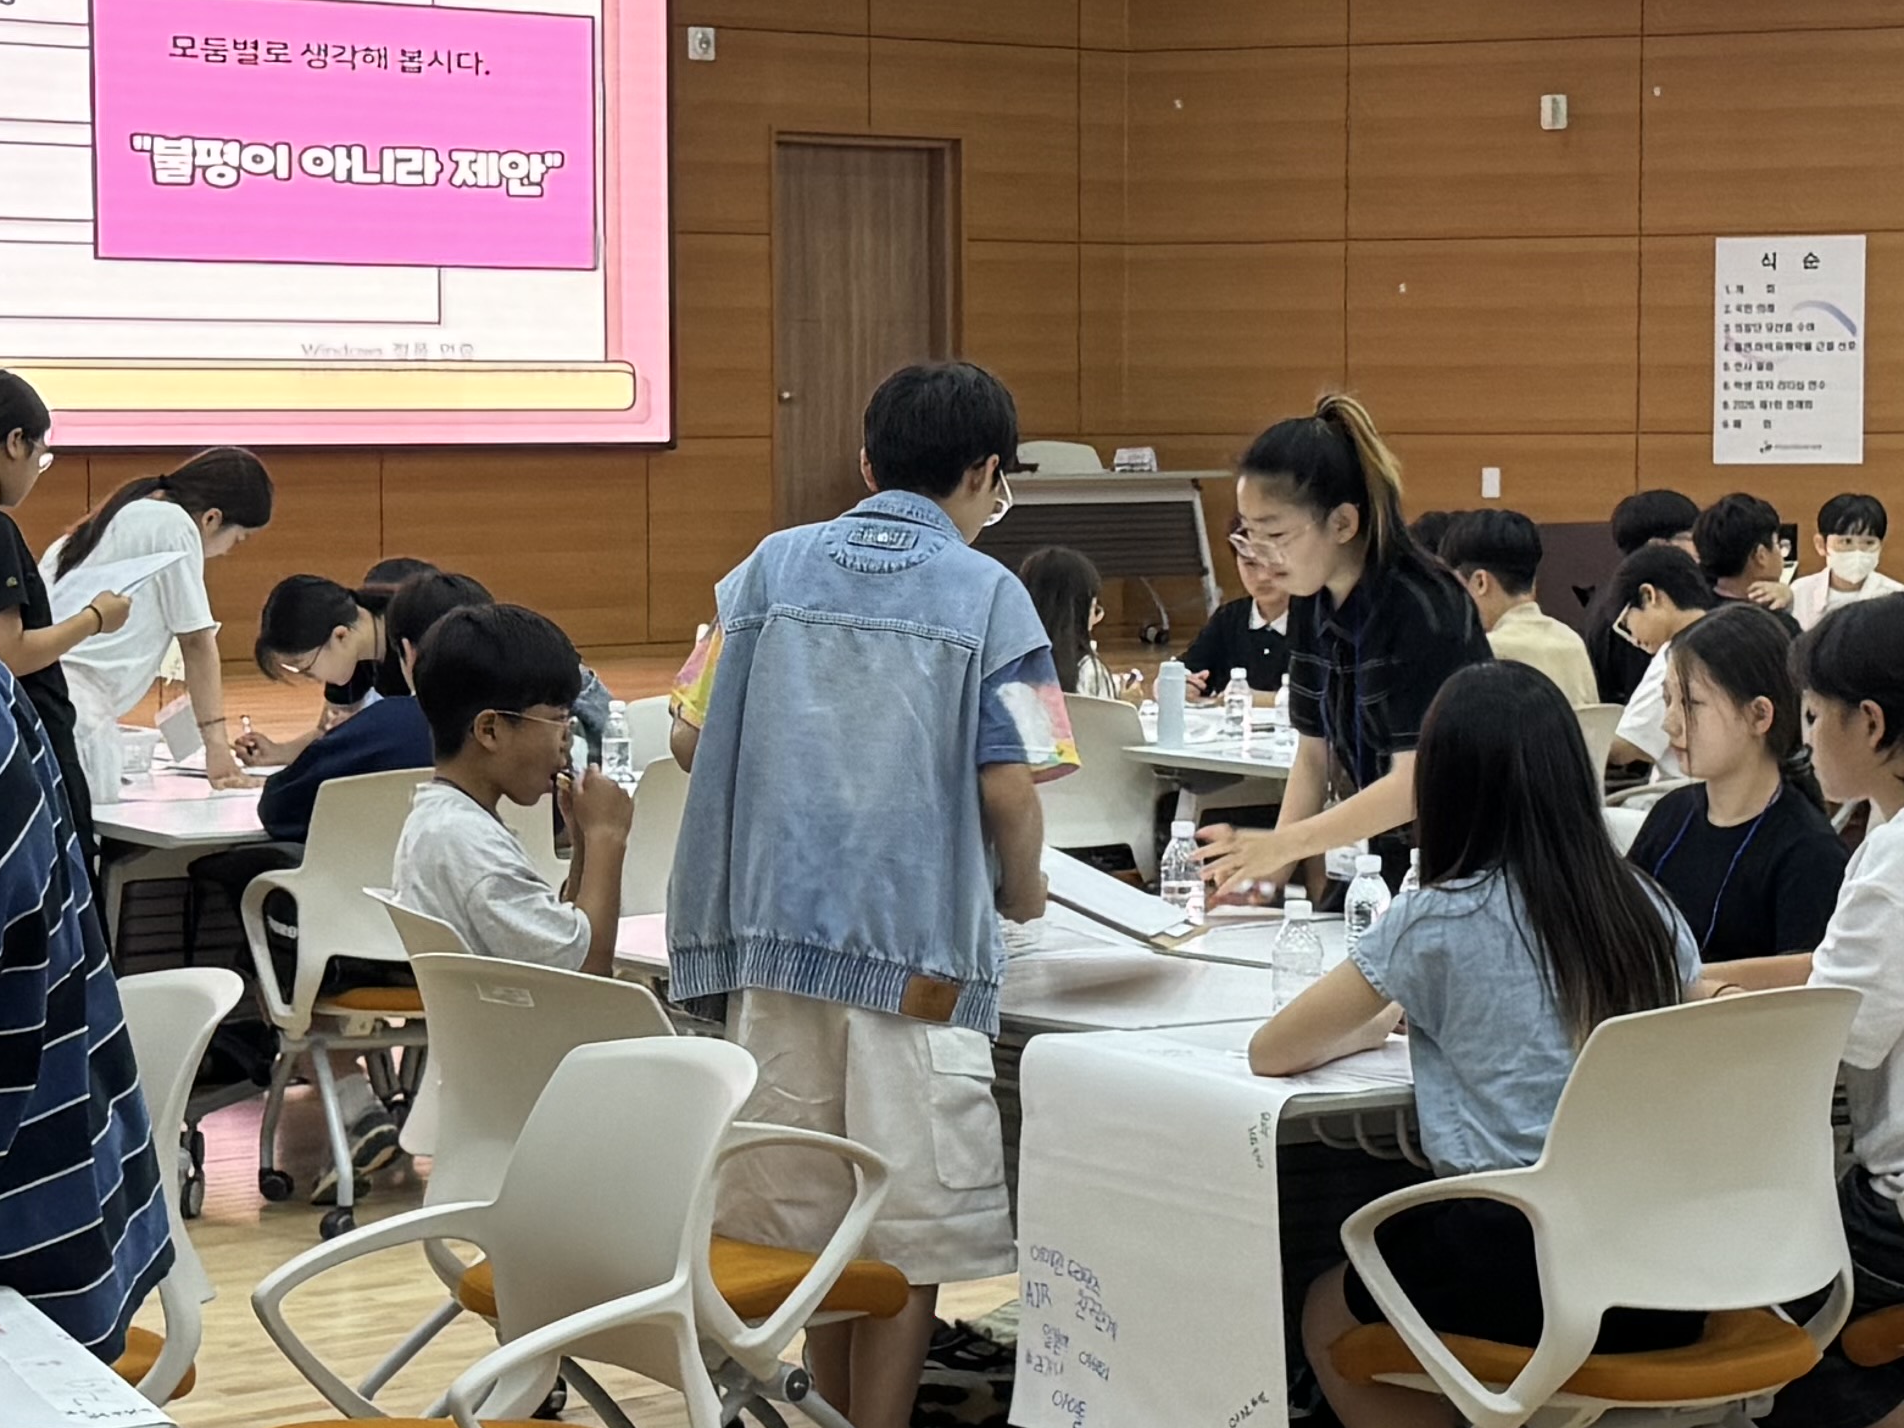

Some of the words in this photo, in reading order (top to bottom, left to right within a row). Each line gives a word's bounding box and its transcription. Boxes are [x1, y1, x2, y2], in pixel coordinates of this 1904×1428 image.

[168, 34, 293, 66] 모둠별로
[300, 41, 388, 71] 생각해
[398, 47, 491, 77] 봅시다.
[130, 132, 292, 189] "불평이
[298, 144, 444, 187] 아니라
[448, 149, 565, 198] 제안"
